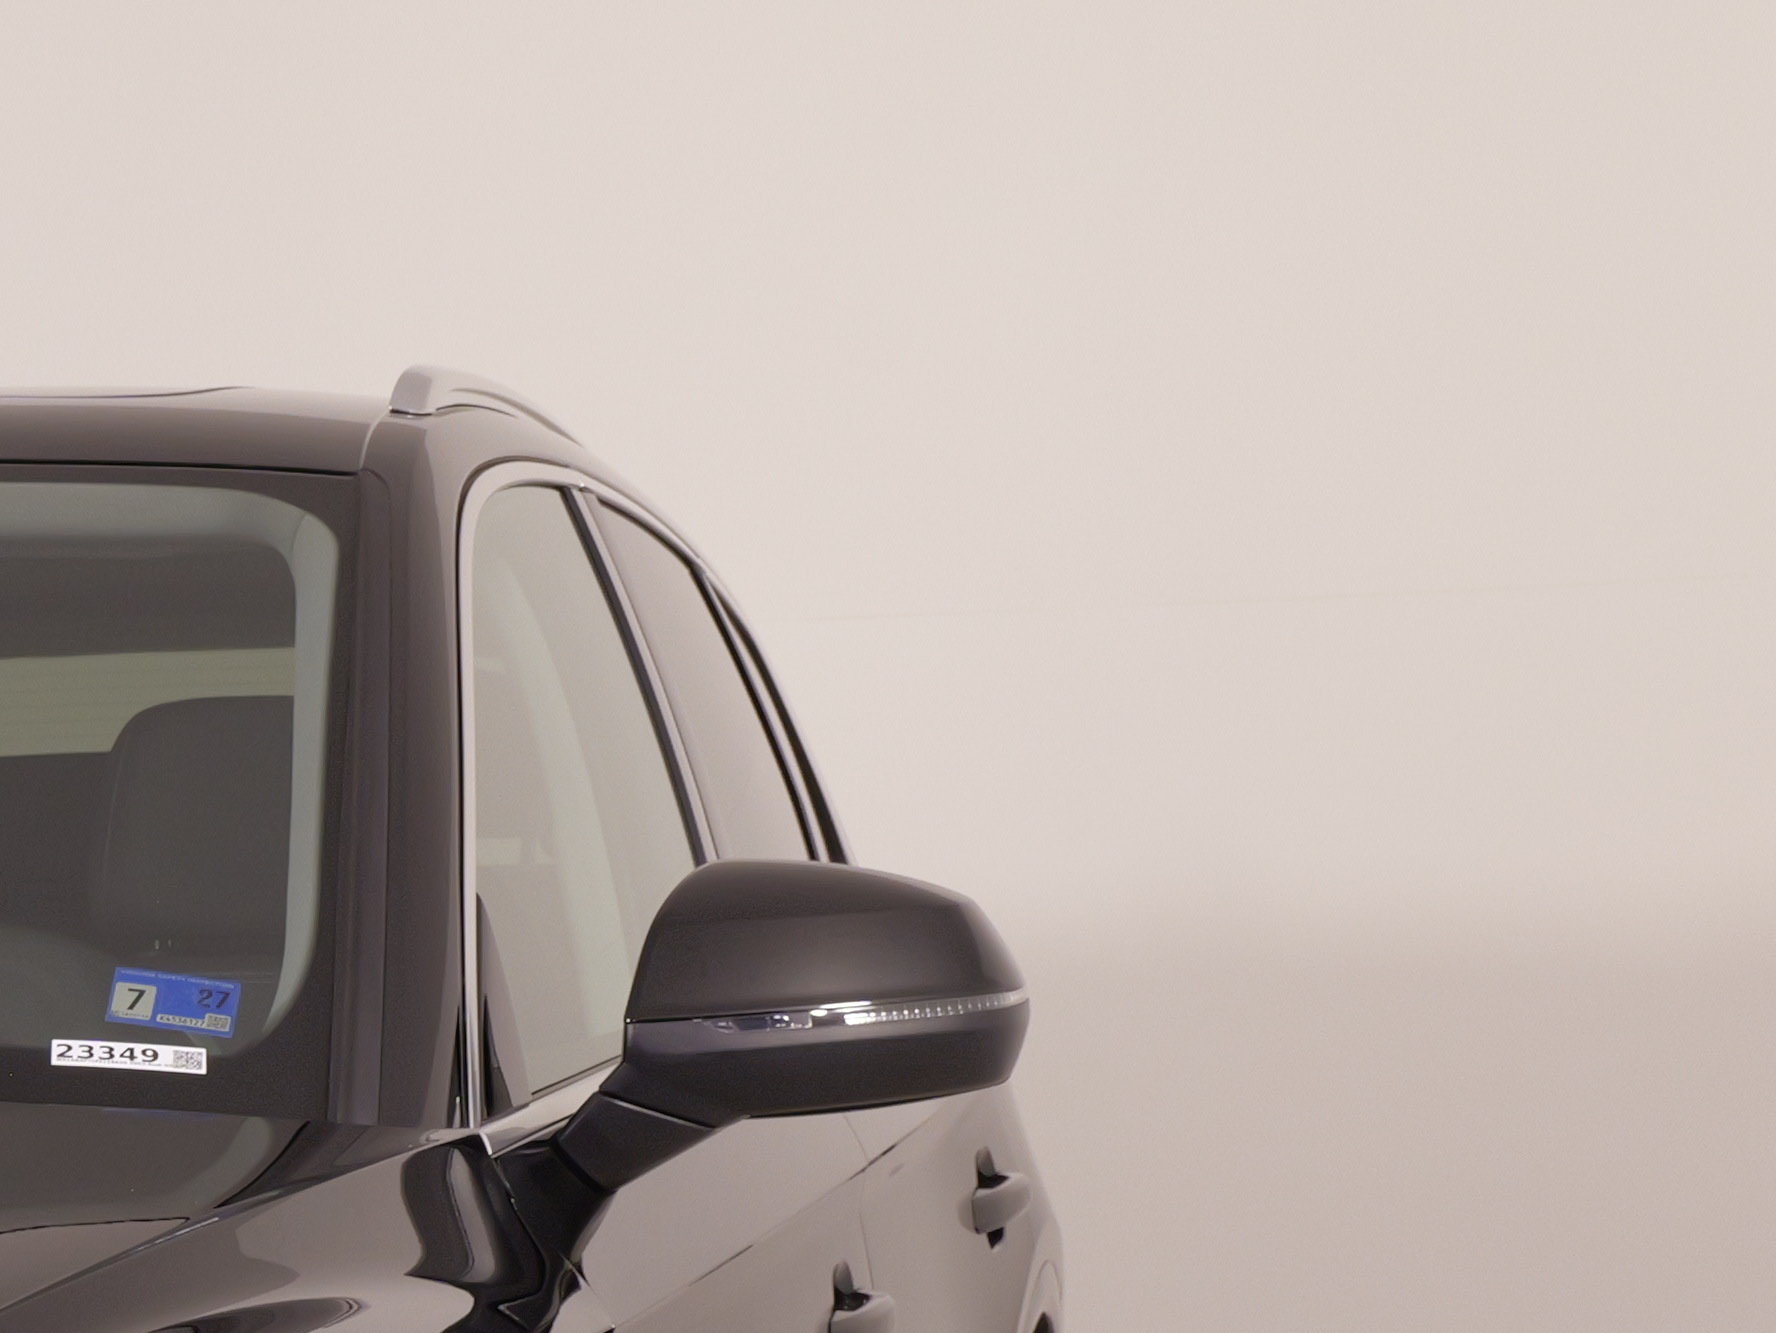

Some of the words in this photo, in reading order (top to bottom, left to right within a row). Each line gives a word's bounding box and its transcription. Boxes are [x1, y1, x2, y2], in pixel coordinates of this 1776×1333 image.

[126, 988, 147, 1011] 7
[198, 988, 232, 1010] 27
[55, 1043, 160, 1063] 23349
